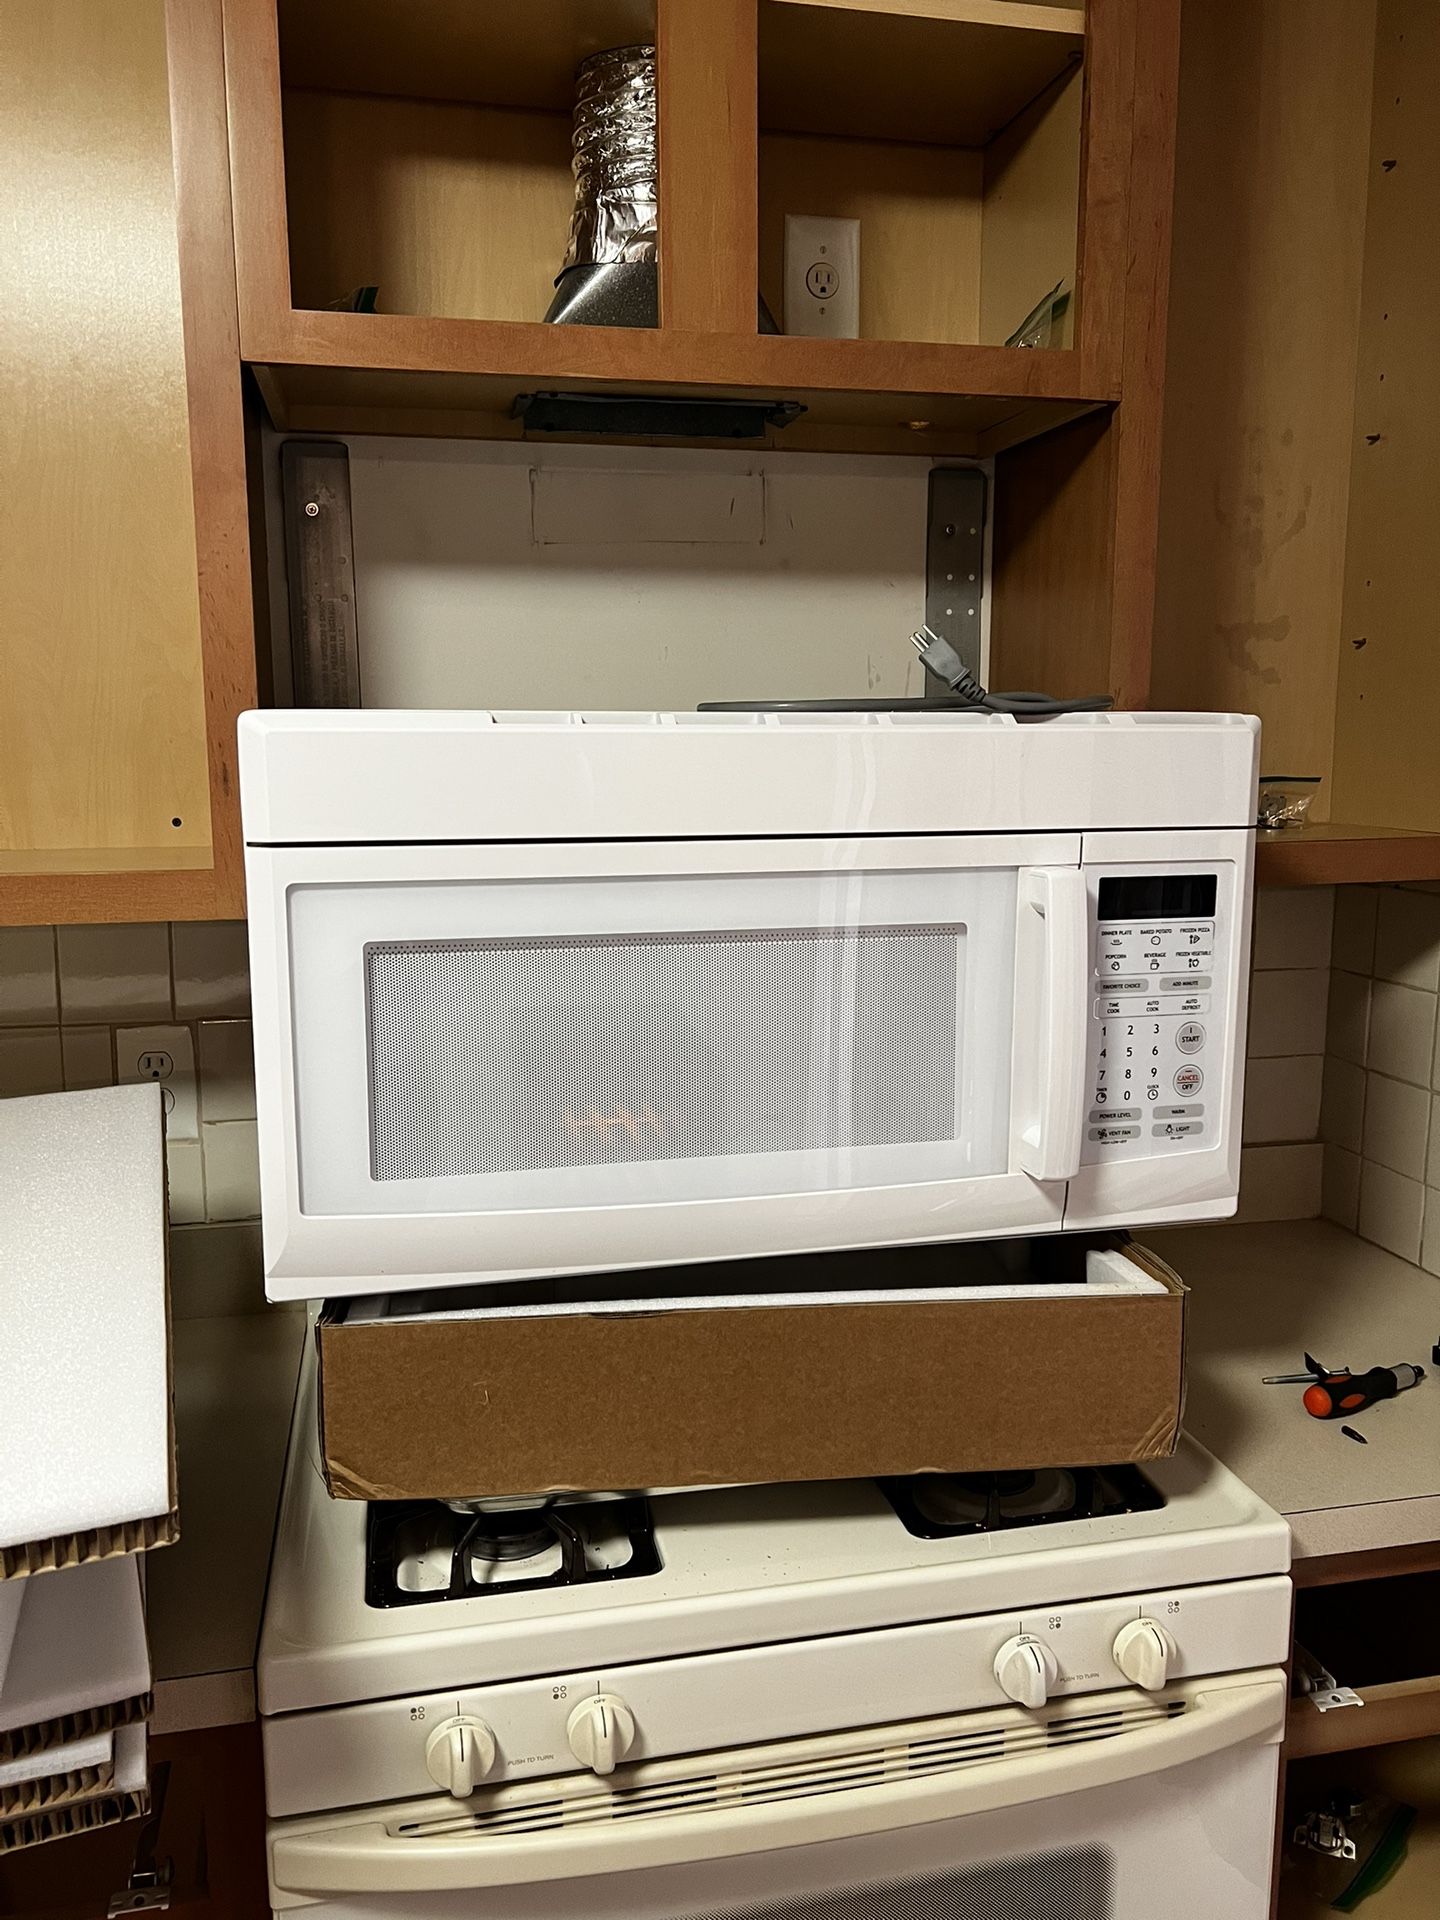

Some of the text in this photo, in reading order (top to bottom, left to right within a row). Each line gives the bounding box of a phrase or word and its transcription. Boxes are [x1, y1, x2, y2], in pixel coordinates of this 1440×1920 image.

[1102, 1027, 1107, 1037] 1
[1128, 1025, 1134, 1036] 2
[1154, 1024, 1160, 1034] 3
[1182, 1035, 1200, 1043] START
[1100, 1048, 1107, 1058] 4
[1127, 1047, 1133, 1057] 5
[1152, 1046, 1158, 1056] 6
[1099, 1071, 1106, 1081] 7
[1125, 1069, 1132, 1080] 8
[1151, 1068, 1158, 1078] 9
[1177, 1074, 1199, 1082] CANCEL
[1124, 1091, 1131, 1101] 0
[507, 1758, 526, 1766] PUSH
[537, 1753, 555, 1763] TURN
